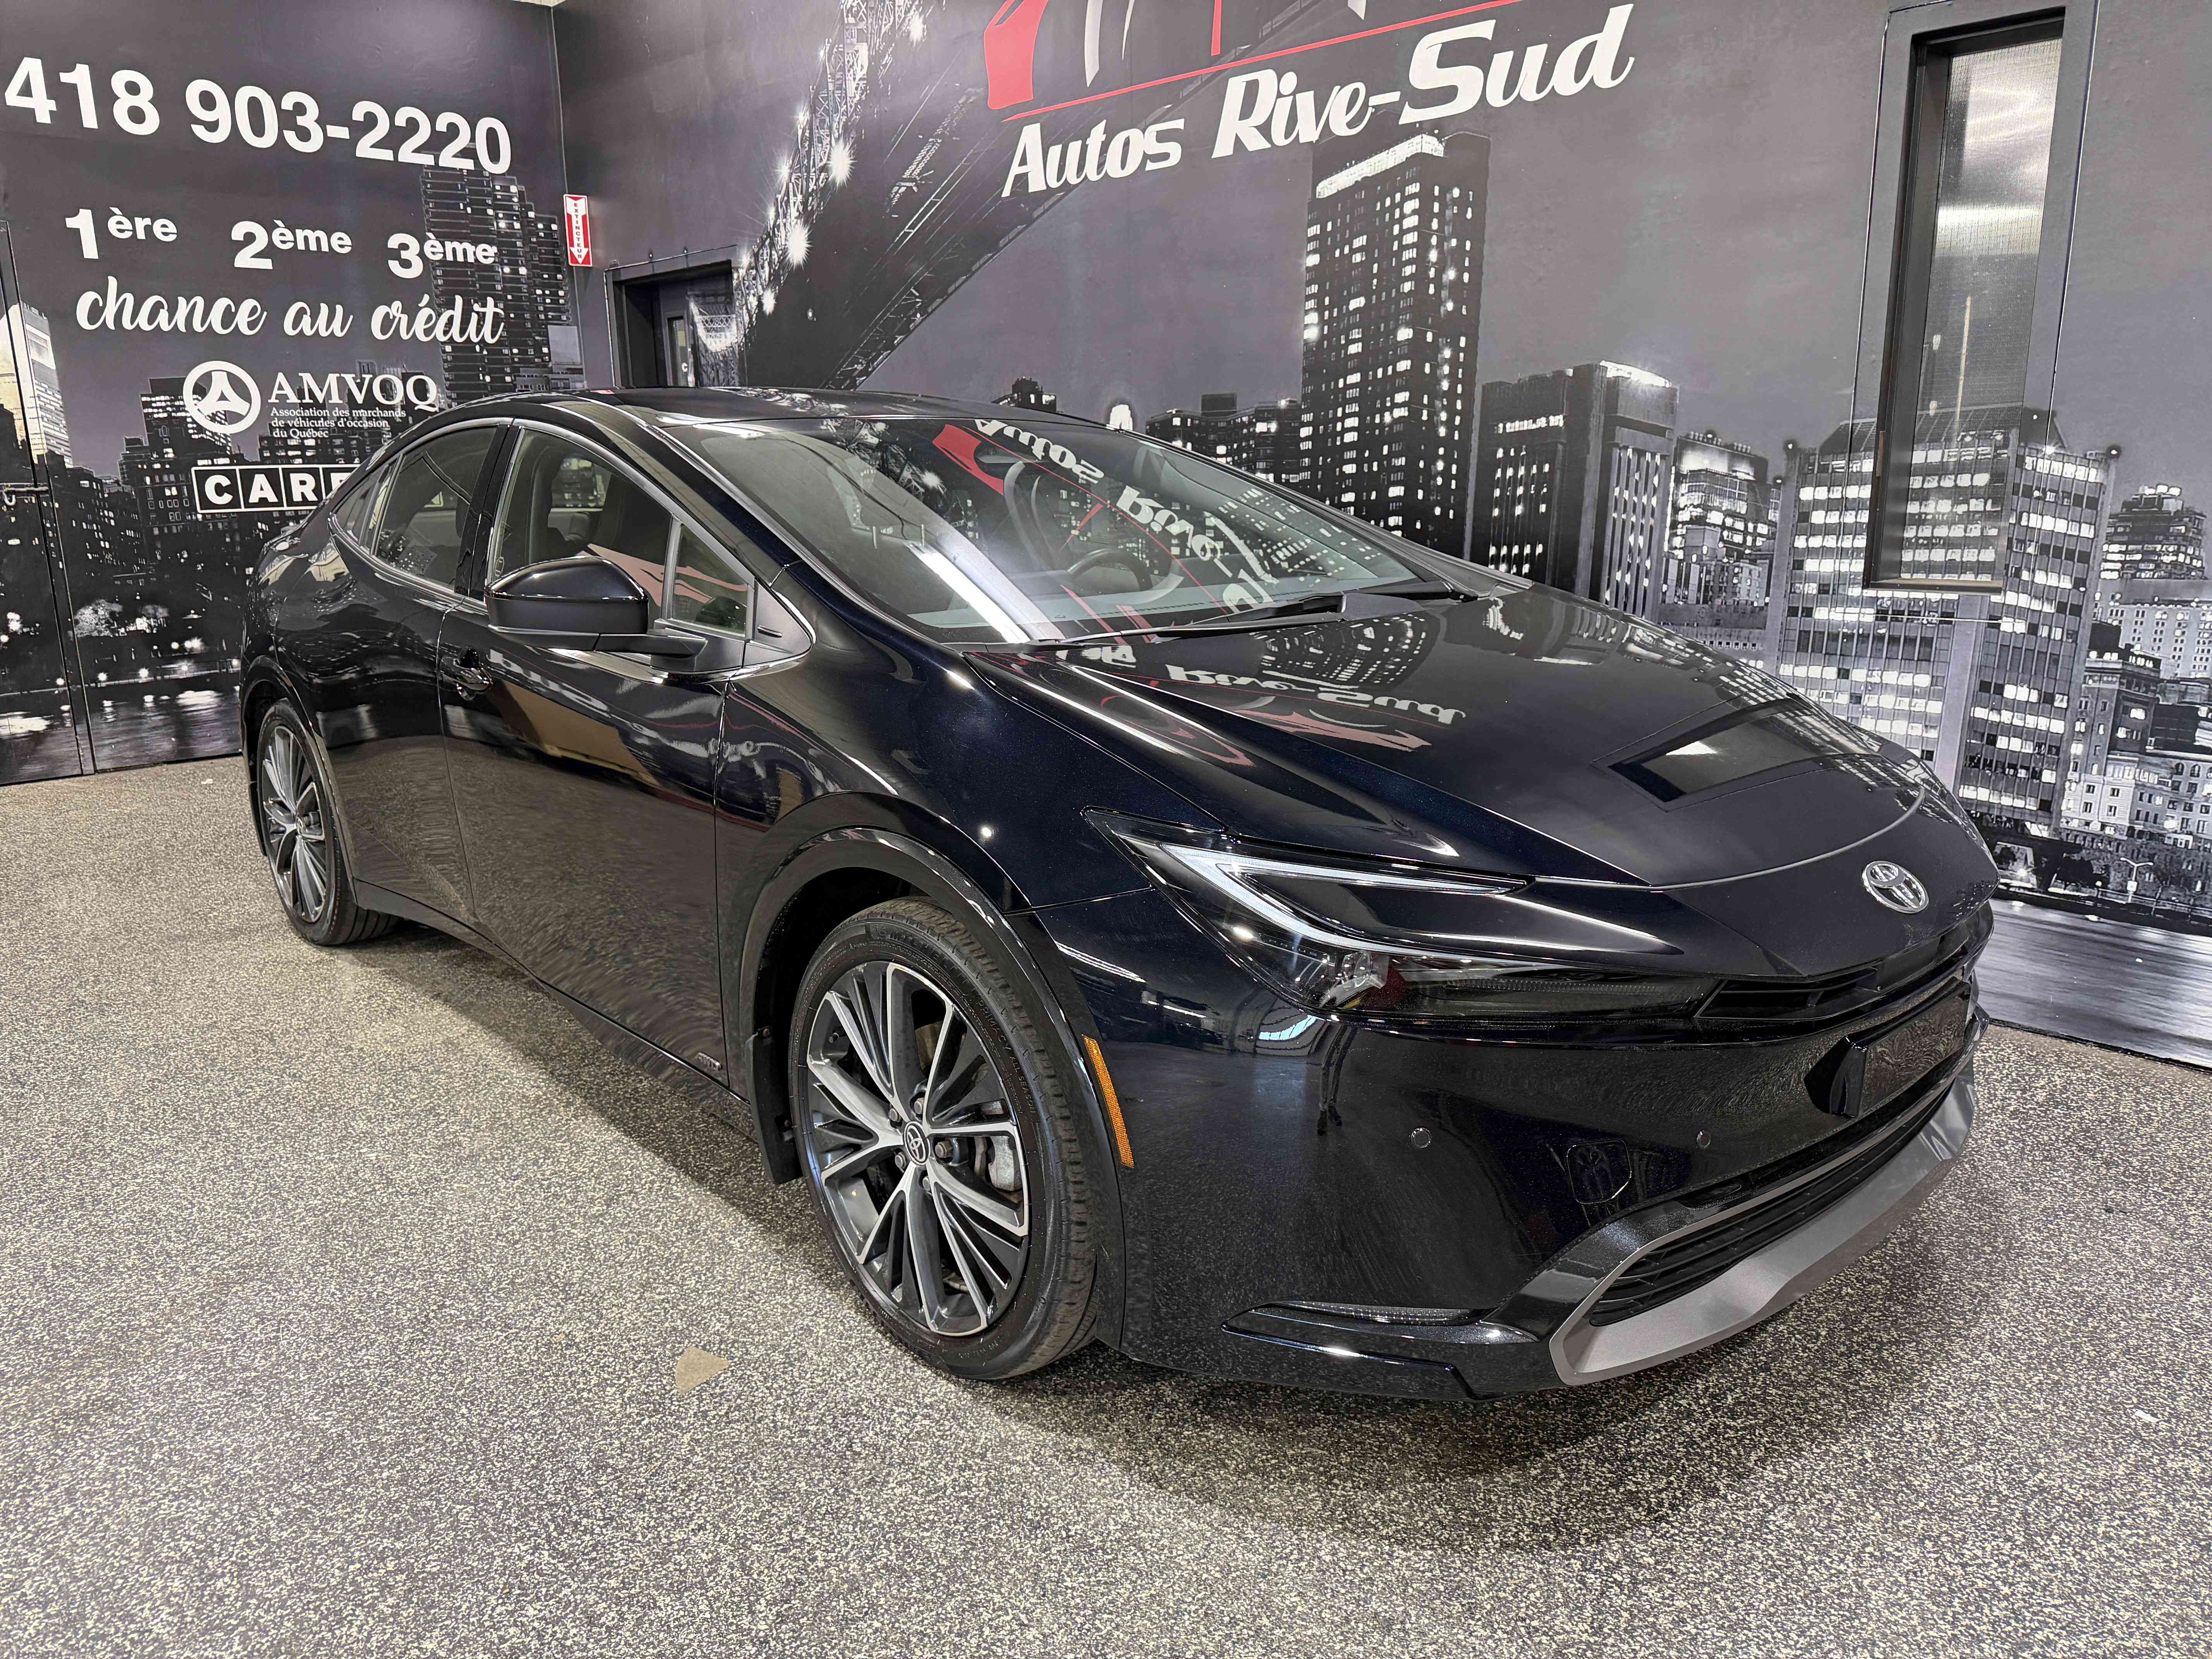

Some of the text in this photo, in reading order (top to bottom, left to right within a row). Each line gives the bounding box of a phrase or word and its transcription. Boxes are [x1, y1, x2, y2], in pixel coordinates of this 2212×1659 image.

[5, 57, 511, 174] 418 903-2220
[1001, 3, 1635, 198] Autos Rive-Sud
[65, 207, 498, 278] 1ère 2ème 3ème
[574, 203, 582, 259] EXTINCTEUR
[76, 276, 505, 344] chance au crédit
[268, 372, 439, 412] AMVOQ
[270, 407, 406, 417] Association des marchands
[271, 417, 390, 428] de véhicules d'occasion
[273, 428, 329, 439] du Québec
[1010, 1056, 1021, 1073] ALL
